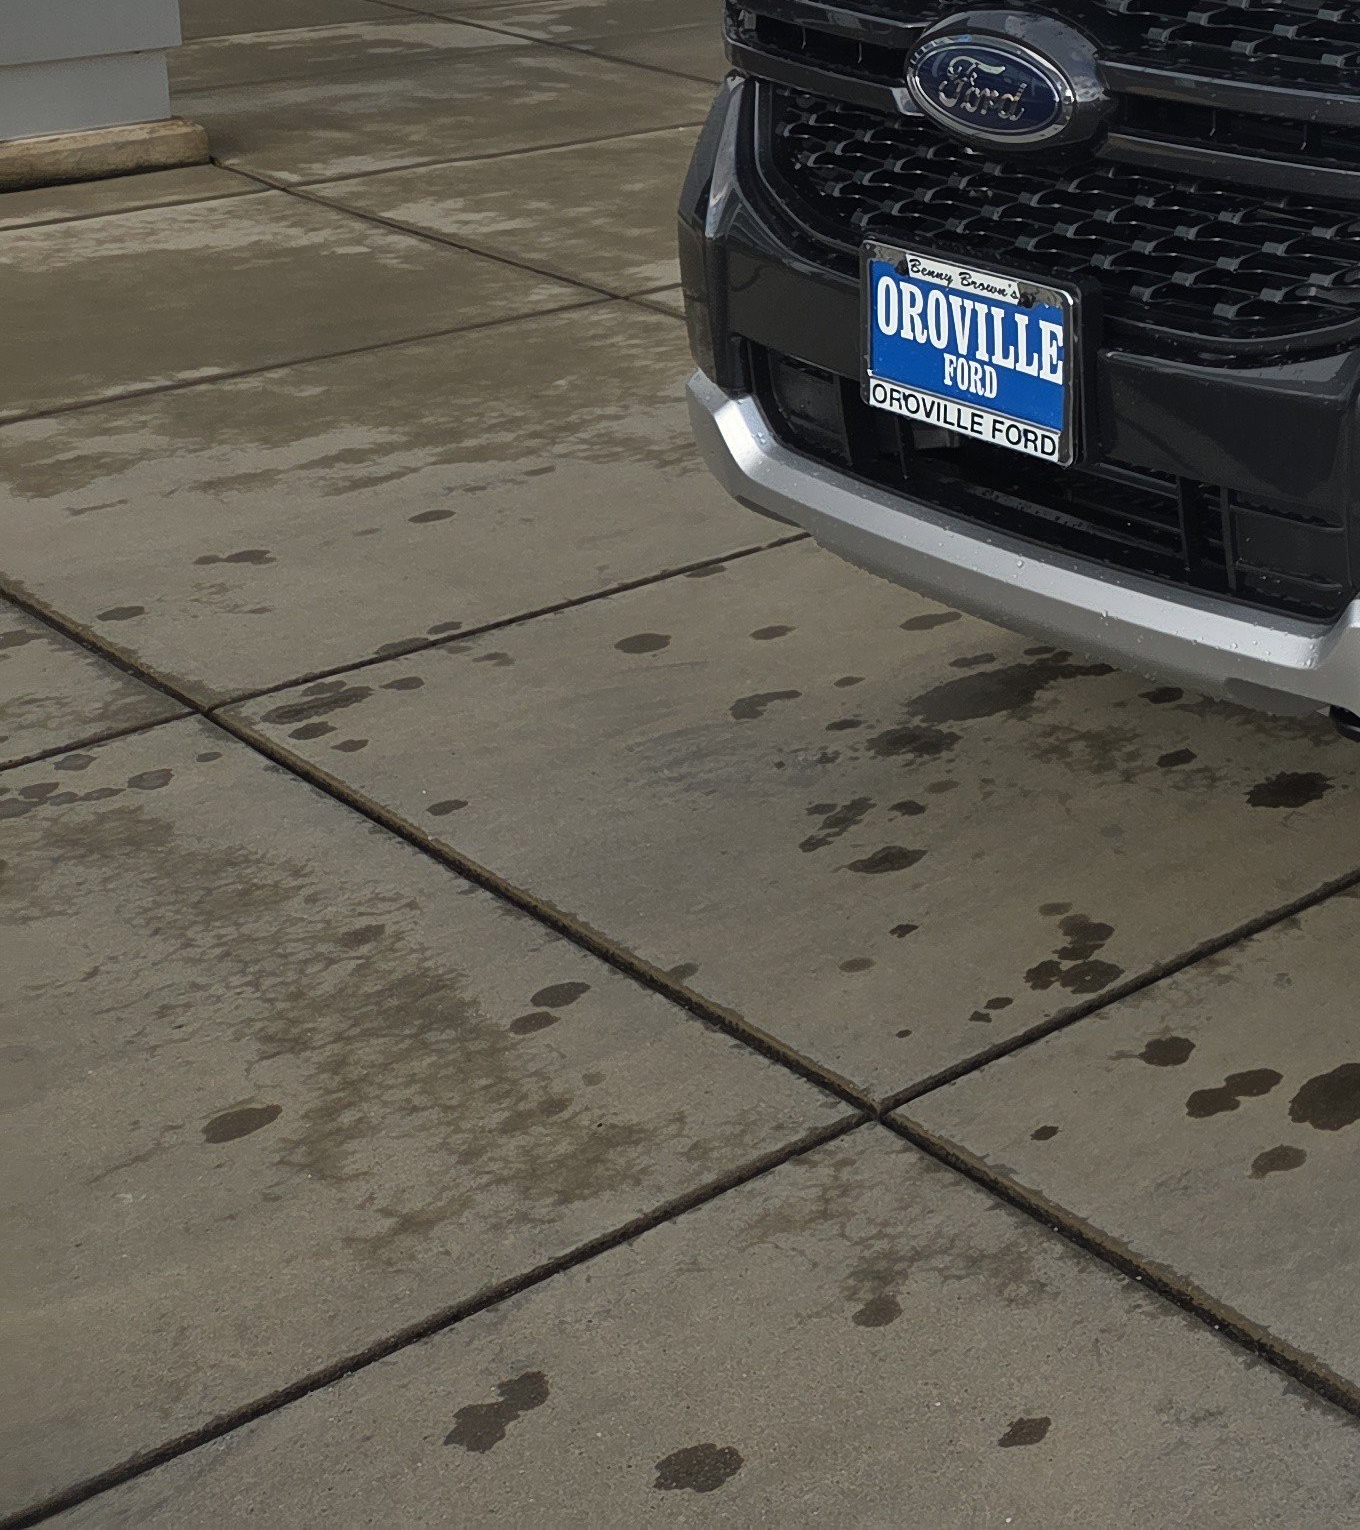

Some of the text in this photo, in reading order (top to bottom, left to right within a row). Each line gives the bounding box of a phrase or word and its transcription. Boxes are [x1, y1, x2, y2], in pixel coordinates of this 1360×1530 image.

[937, 54, 1028, 121] Ford
[909, 258, 1019, 299] Benny Brown's
[877, 275, 1064, 385] OROVILLE
[943, 352, 998, 398] FORD
[872, 383, 1057, 456] OROVILLE FORD
